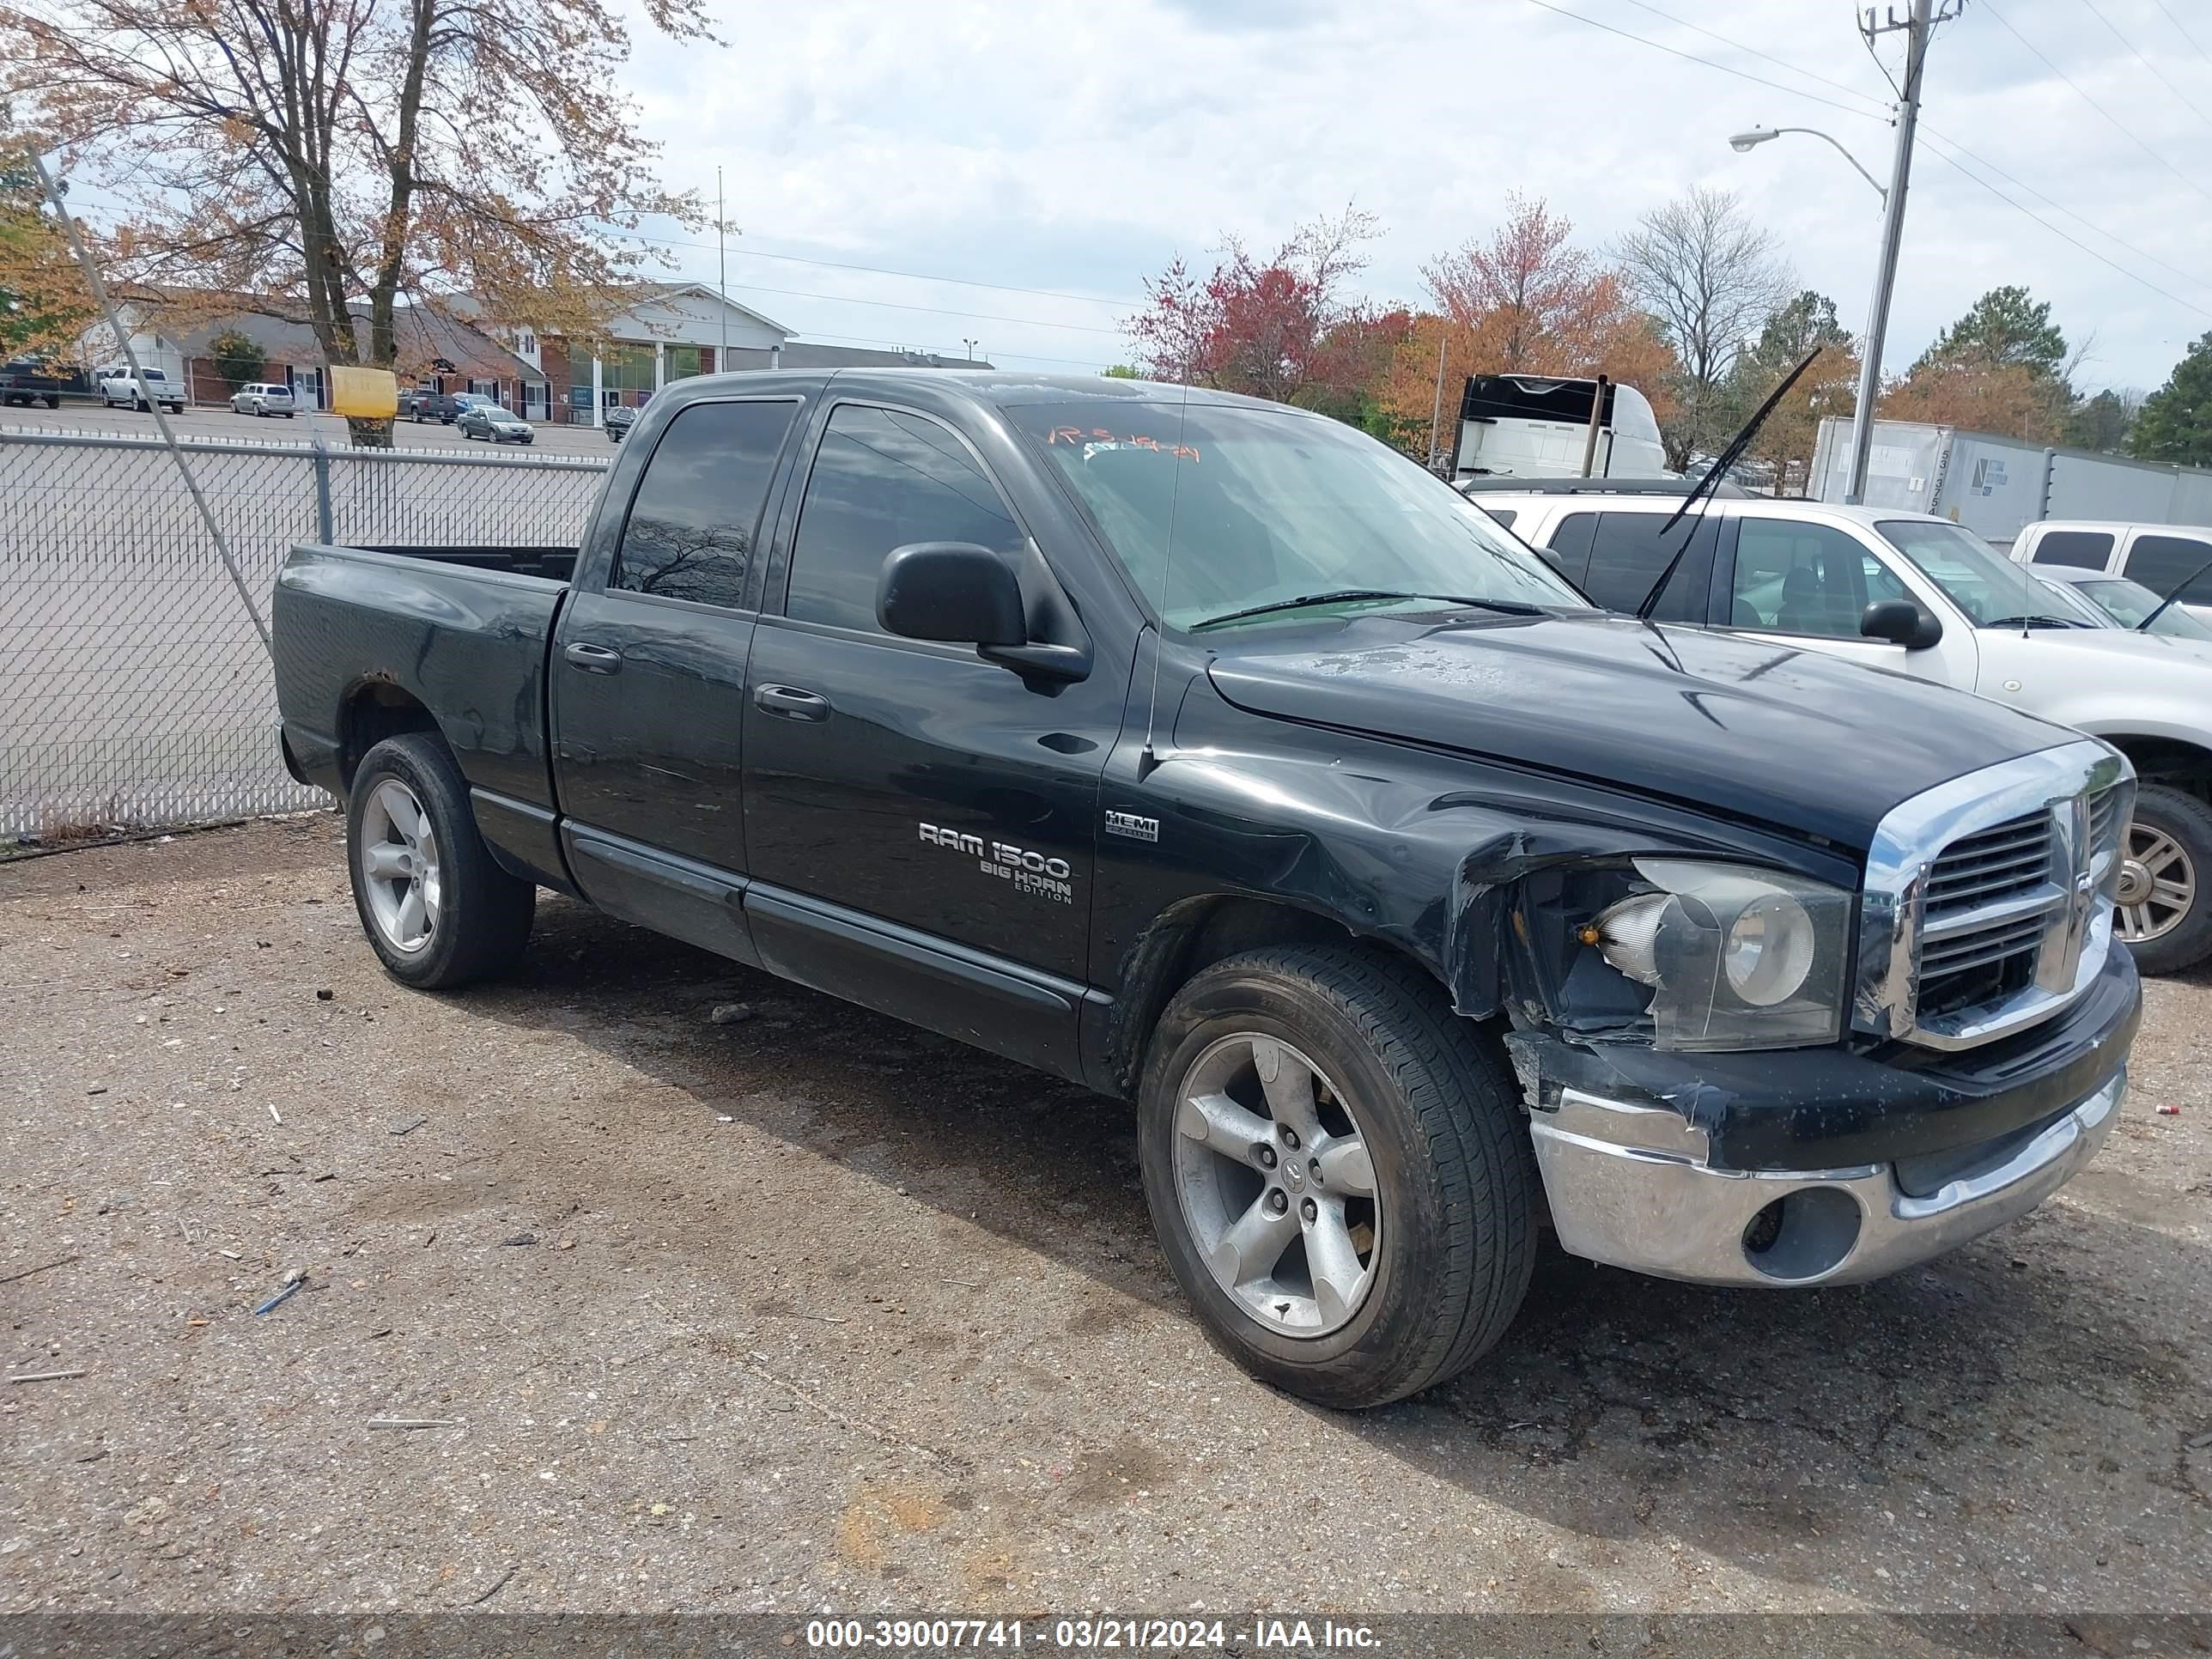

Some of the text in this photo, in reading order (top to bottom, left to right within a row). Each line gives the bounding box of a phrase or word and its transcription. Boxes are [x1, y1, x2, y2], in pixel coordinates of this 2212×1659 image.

[1105, 811, 1157, 832] HEMI
[919, 822, 1070, 879] RAM 1500
[980, 860, 1072, 896] BIG HORN
[1015, 881, 1072, 905] EDITION
